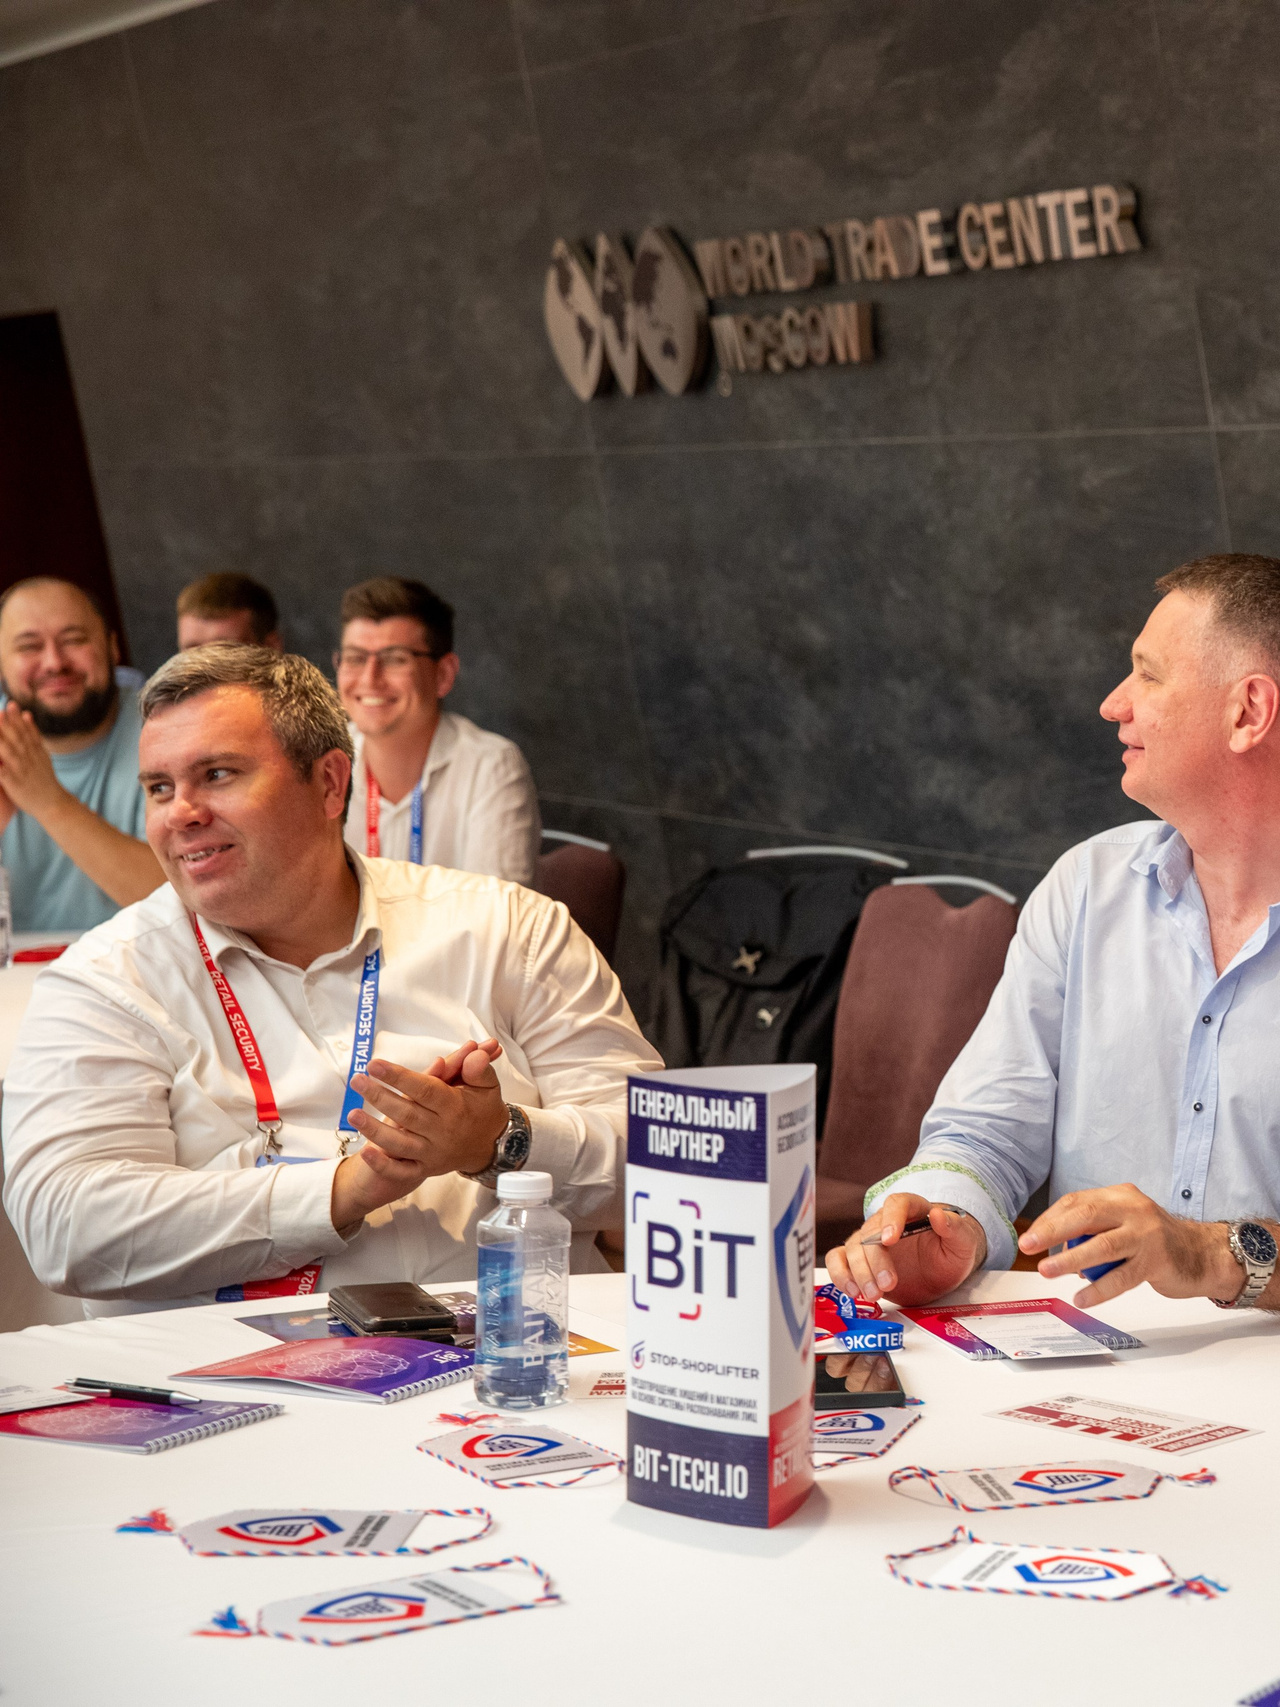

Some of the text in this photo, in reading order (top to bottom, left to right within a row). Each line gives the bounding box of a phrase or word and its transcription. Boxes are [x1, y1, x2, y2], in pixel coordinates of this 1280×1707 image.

[693, 184, 1133, 299] WORLD TRADE CENTER
[710, 302, 872, 373] MOSCOW
[210, 970, 263, 1072] RETAIL SECURITY
[353, 979, 376, 1077] ETAIL SECURITY
[630, 1086, 757, 1132] ГЕНЕРАЛЬНЫЙ
[648, 1125, 725, 1164] ПАРТНЕР
[296, 1270, 317, 1296] 2024
[646, 1220, 756, 1299] BiT
[523, 1258, 545, 1369] BAIKAL
[650, 1352, 760, 1380] STOP-SHOPLIFTER
[716, 1395, 758, 1409] МАГАЗИНАХ
[633, 1444, 749, 1500] BIT-TECH.IO
